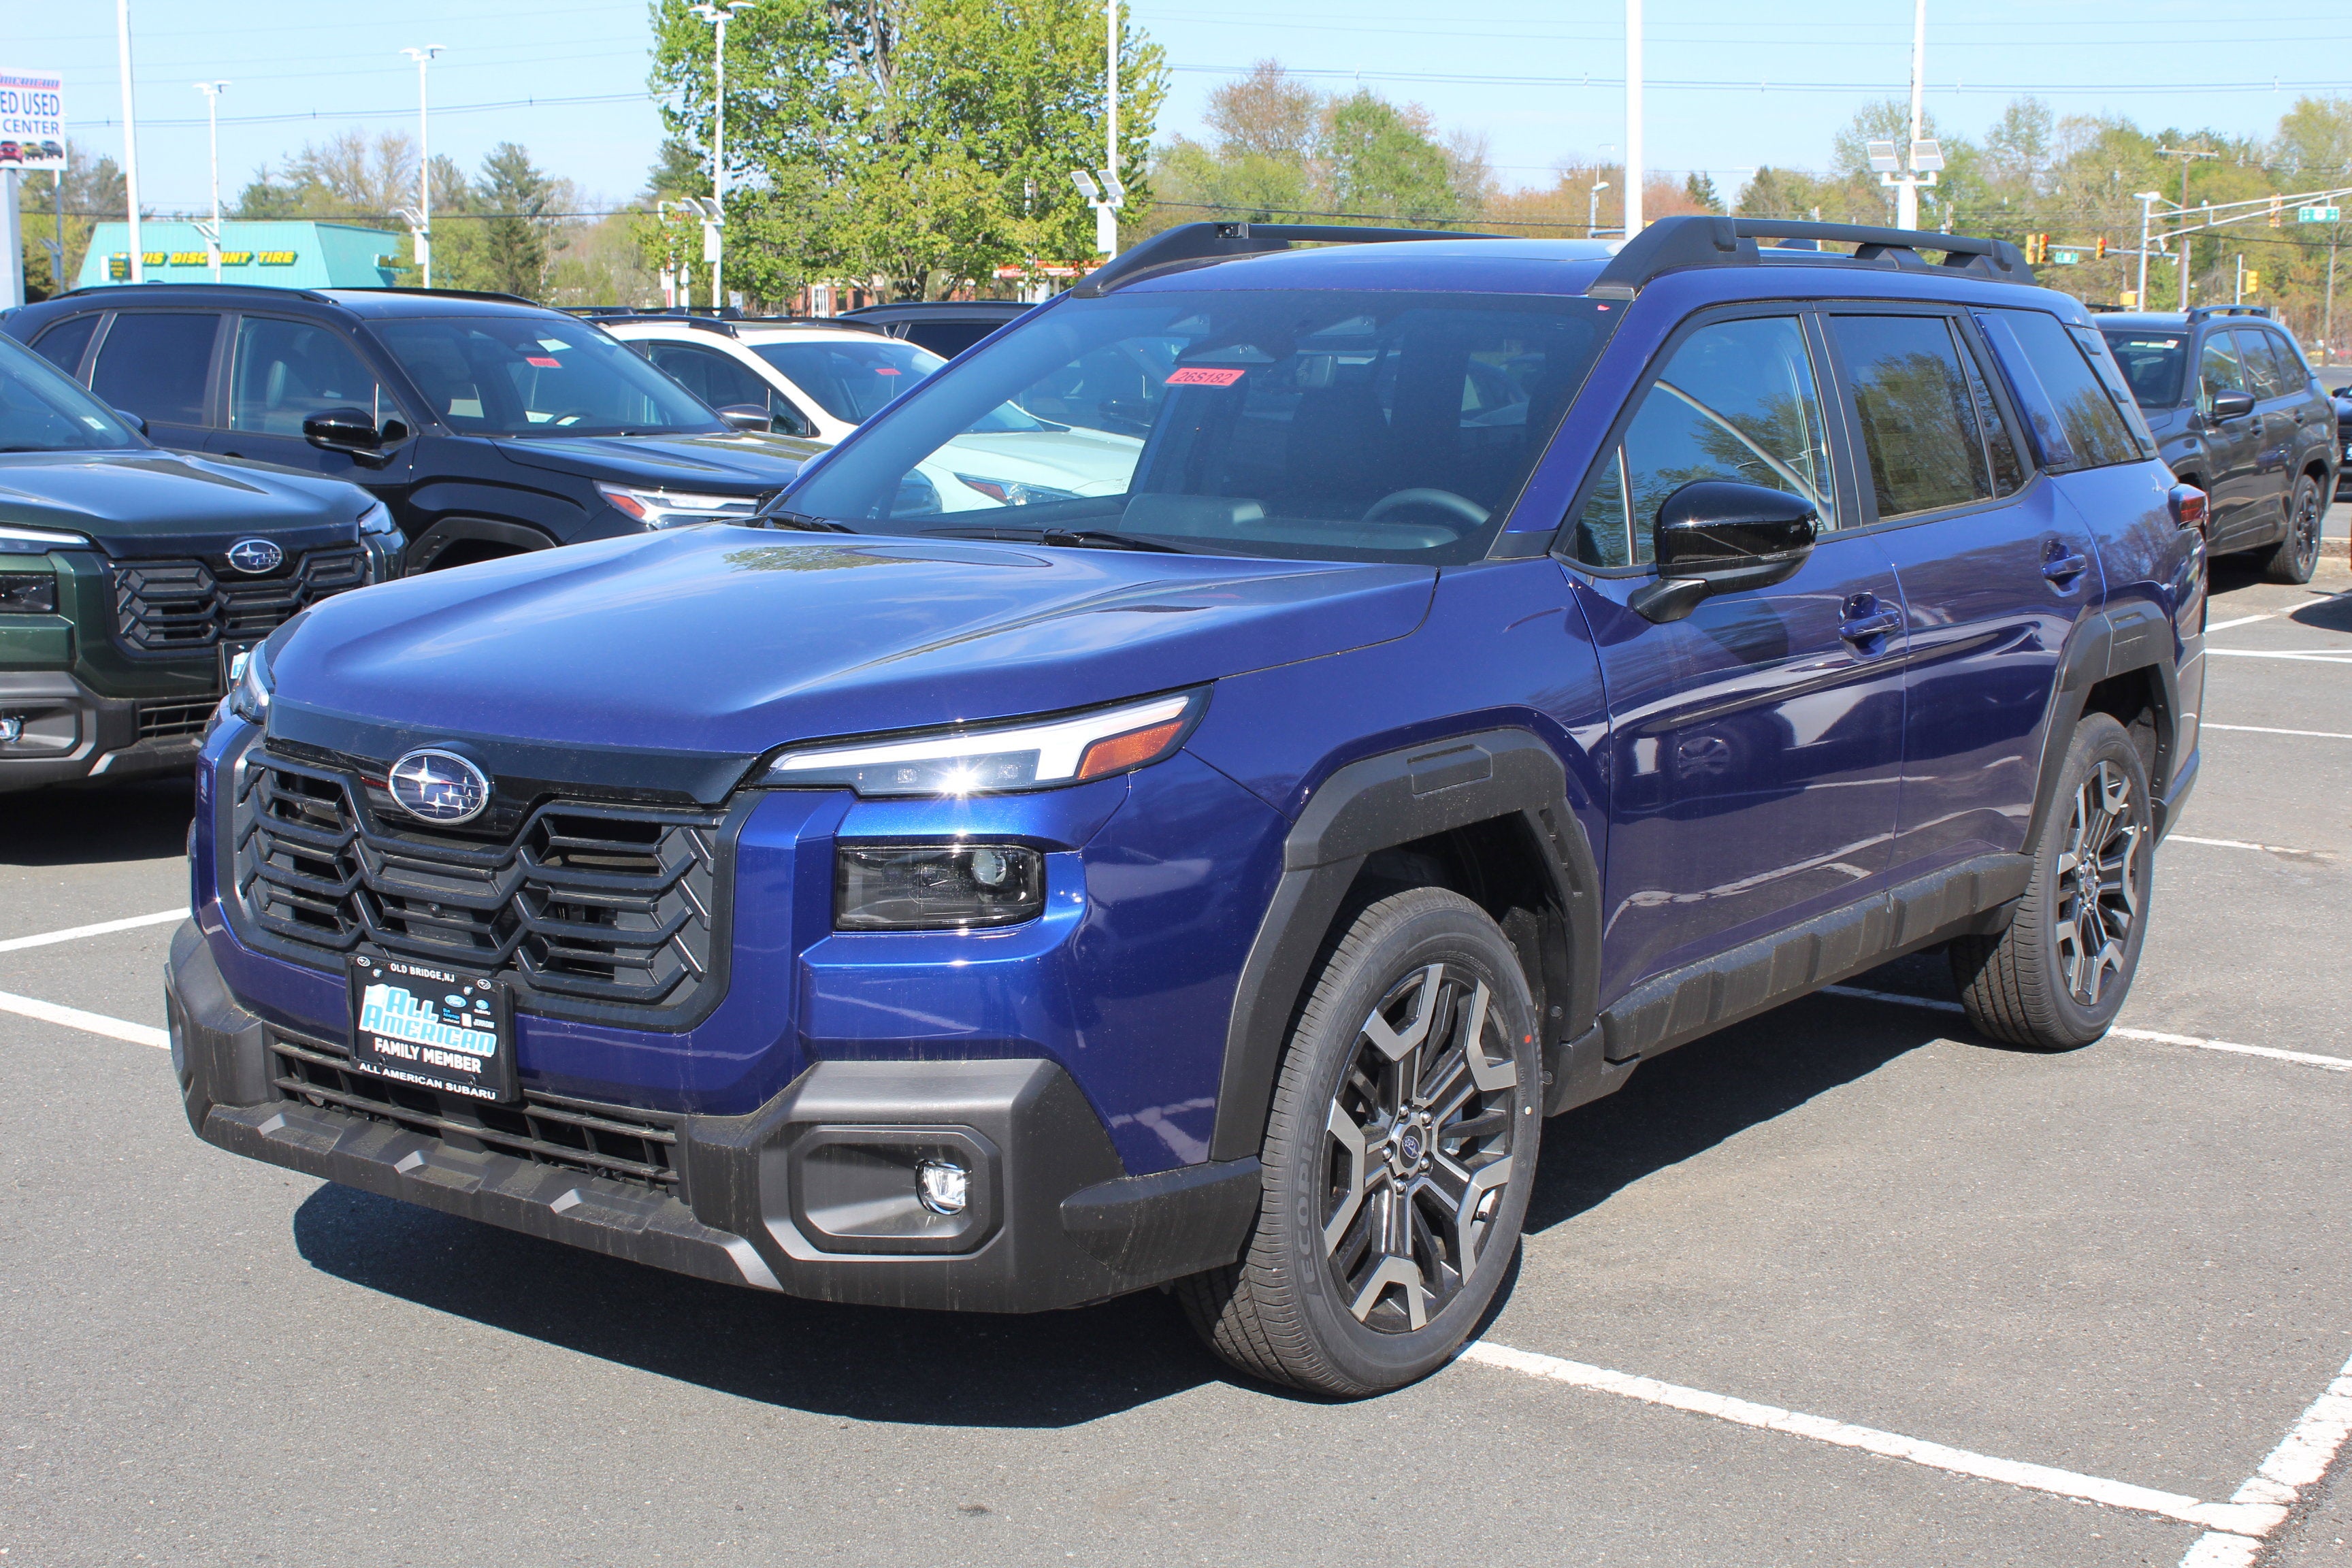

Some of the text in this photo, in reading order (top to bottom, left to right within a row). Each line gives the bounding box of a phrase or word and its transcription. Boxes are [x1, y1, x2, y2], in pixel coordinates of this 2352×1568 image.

[22, 92, 60, 116] USED
[3, 118, 60, 135] CENTER
[170, 252, 252, 265] DISCUNT
[258, 251, 295, 265] TIRE
[1175, 372, 1232, 382] 26S182
[390, 962, 408, 973] OLD
[386, 987, 439, 1022] ALL
[360, 1003, 497, 1056] AMERICAN
[374, 1036, 482, 1073] FAMILY MEMBER
[359, 1062, 496, 1100] ALL AMERICAN SUBARU
